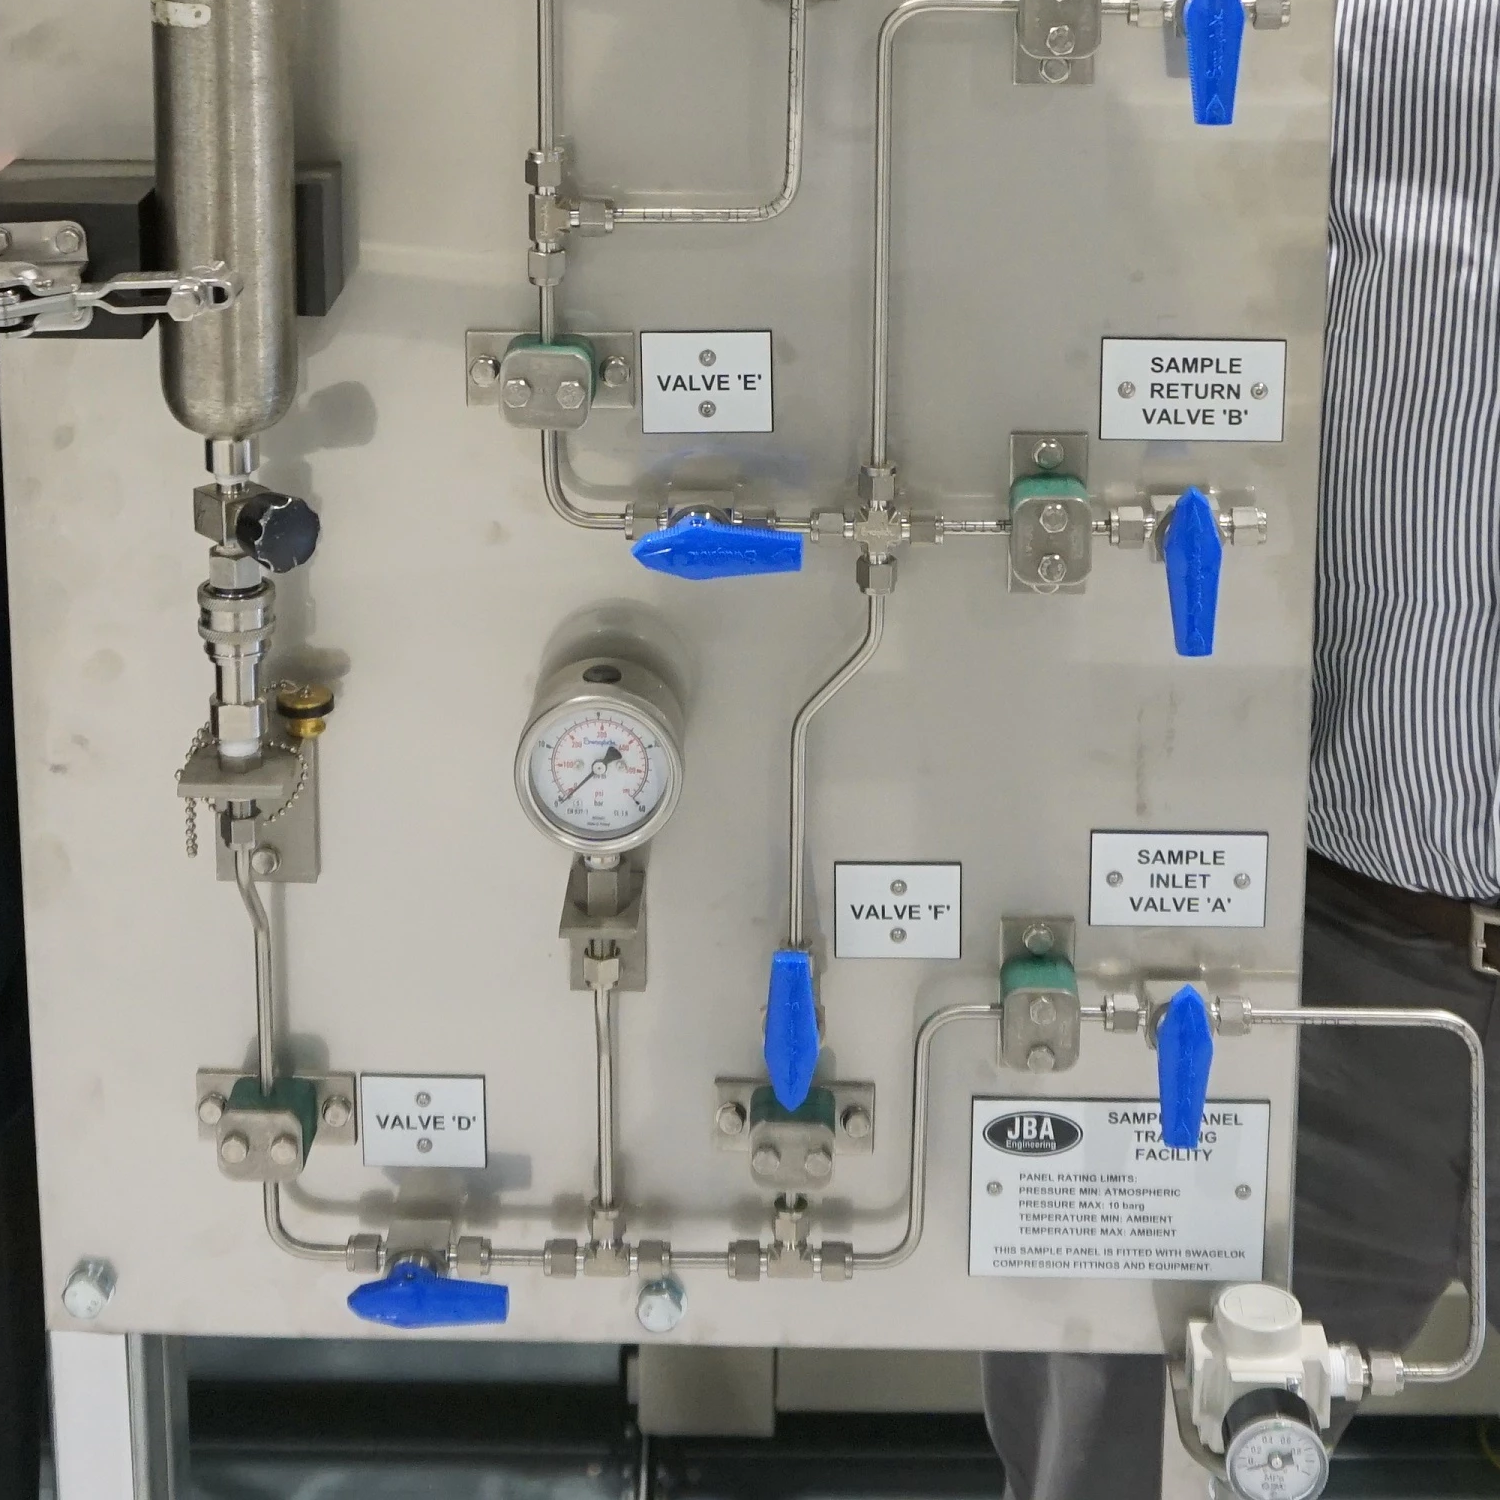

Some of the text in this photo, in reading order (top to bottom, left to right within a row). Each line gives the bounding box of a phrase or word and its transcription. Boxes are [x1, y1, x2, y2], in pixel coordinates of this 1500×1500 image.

[1150, 357, 1243, 374] SAMPLE
[657, 374, 762, 391] VALVE 'E'
[1150, 383, 1241, 400] RETURN
[1142, 408, 1249, 425] VALVE 'B'
[1137, 849, 1225, 866] SAMPLE
[1150, 873, 1211, 889] INLET
[1129, 896, 1231, 913] VALVE 'A'
[850, 904, 951, 920] VALVE 'F'
[376, 1114, 477, 1131] VALVE 'D'
[1108, 1112, 1244, 1126] SAMP ANEL
[1007, 1116, 1055, 1140] JBA
[1134, 1130, 1217, 1143] TRANG
[1006, 1140, 1056, 1150] Engineering
[1135, 1148, 1213, 1161] FACILITY
[1020, 1173, 1138, 1183] PANEL RATING LIMITS:
[1019, 1187, 1181, 1197] PRESSURE MIN: ATMOSPHERIC
[1019, 1200, 1076, 1209] PRESSURE
[1079, 1201, 1105, 1209] MAX:
[1122, 1202, 1145, 1211] barg
[1020, 1213, 1173, 1223] TEMPERATURE MIN: AMBIENT
[1019, 1227, 1177, 1237] TEMPERATURE MAX: AMBIENT
[994, 1246, 1017, 1255] THIS
[1020, 1247, 1062, 1255] SAMPLE
[1065, 1247, 1100, 1256] PANEL
[1116, 1249, 1152, 1257] FITTED
[1155, 1249, 1182, 1257] WITH
[1185, 1250, 1246, 1258] SWAGELOK
[992, 1260, 1212, 1271] COMPRESSION FITTINGS AND EQUIPMENT.
